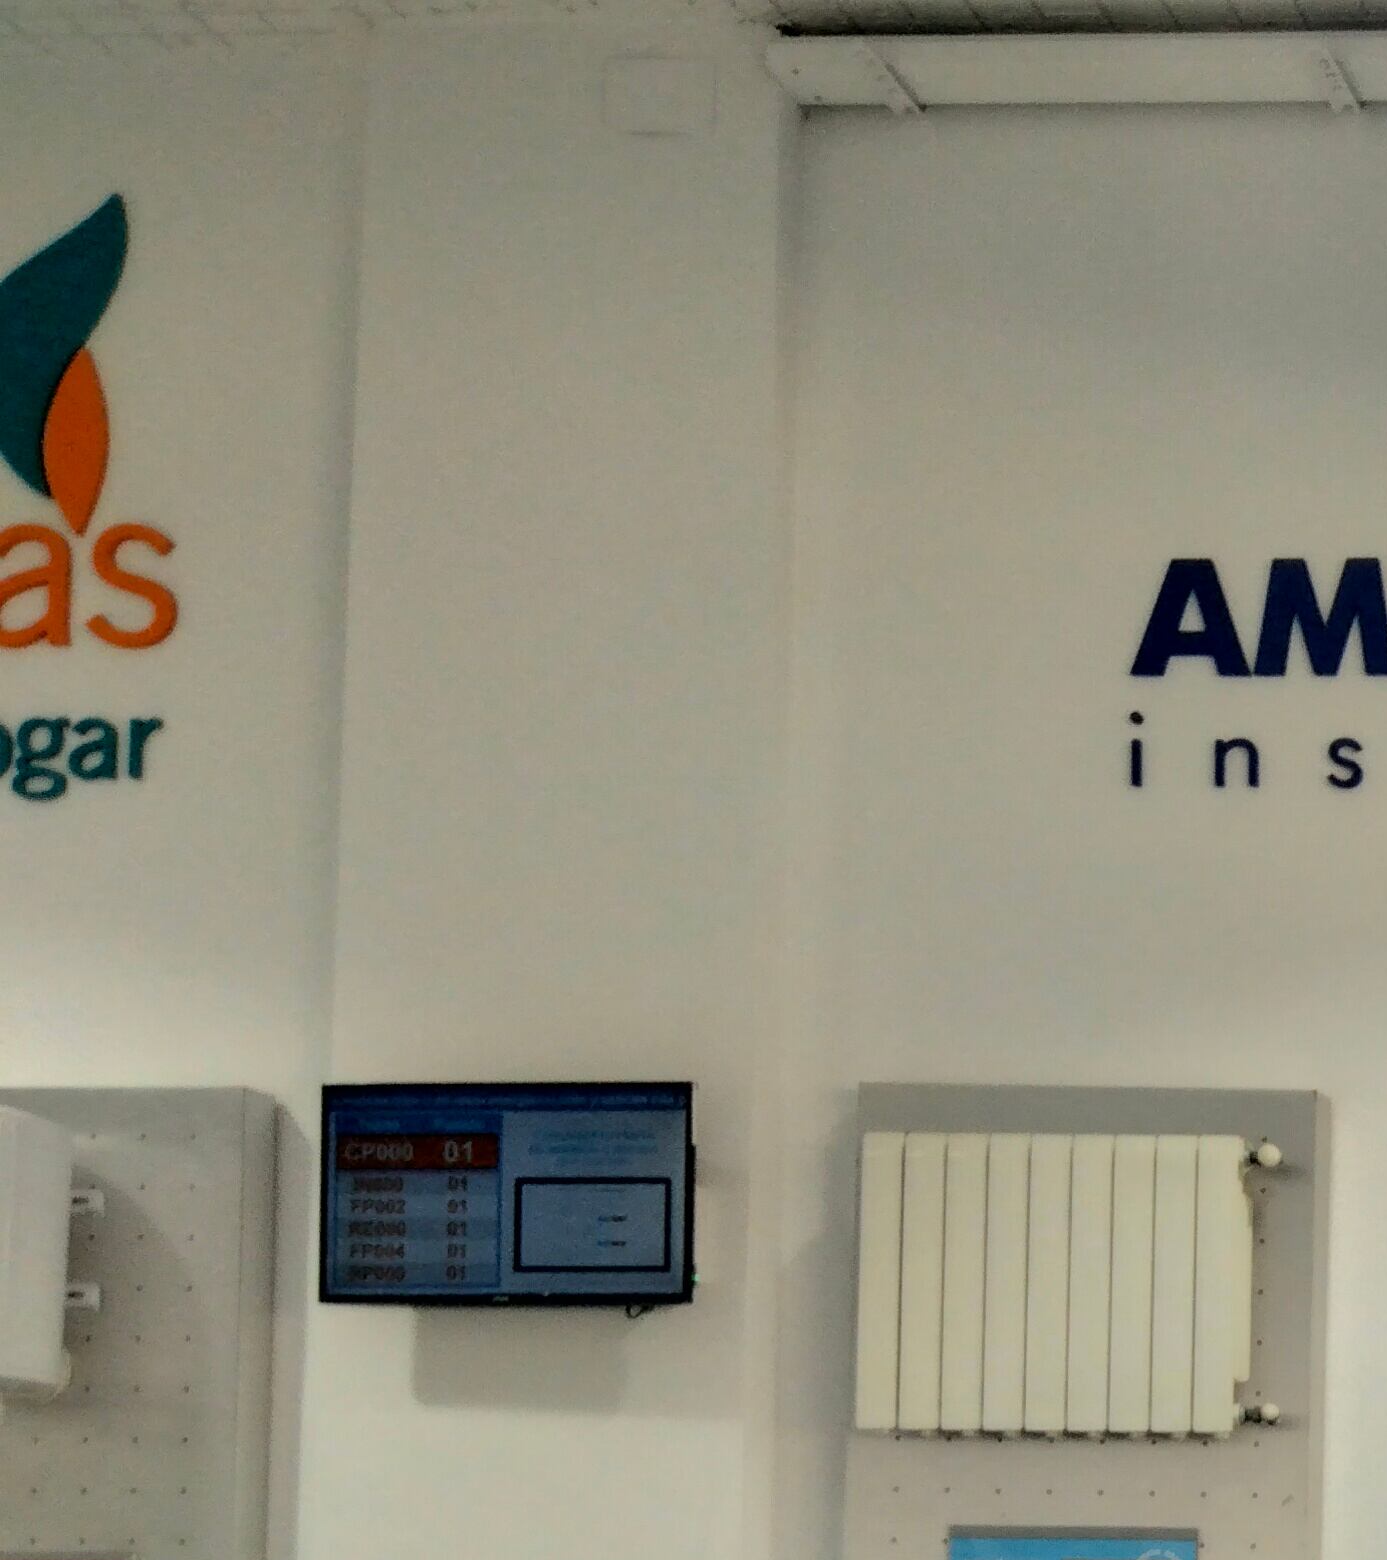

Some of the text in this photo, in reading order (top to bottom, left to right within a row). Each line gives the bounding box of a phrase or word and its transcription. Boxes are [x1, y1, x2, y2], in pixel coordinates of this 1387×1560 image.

[0, 523, 178, 649] as
[0, 717, 164, 802] gar
[444, 1140, 473, 1162] 01
